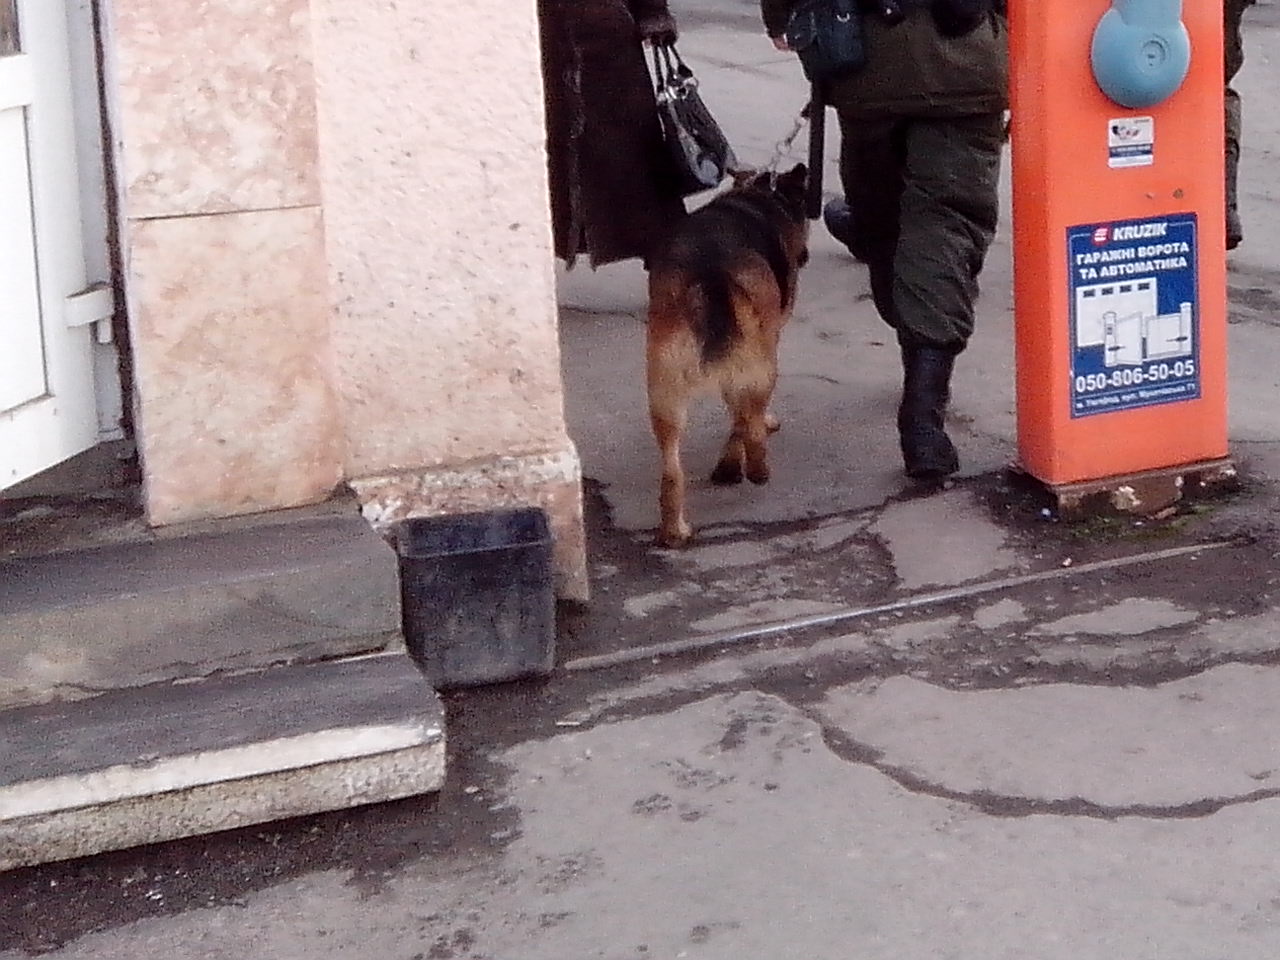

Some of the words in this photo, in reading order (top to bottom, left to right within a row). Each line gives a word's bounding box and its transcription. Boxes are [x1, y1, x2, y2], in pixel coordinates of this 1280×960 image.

[1113, 222, 1168, 241] KRUZIK
[1076, 248, 1135, 266] ГАРАЖНІ
[1137, 242, 1190, 258] ВОРОТА
[1079, 267, 1098, 280] ТА
[1100, 256, 1188, 277] АВТОМАТИКА
[1075, 360, 1195, 393] 050-806-50-05
